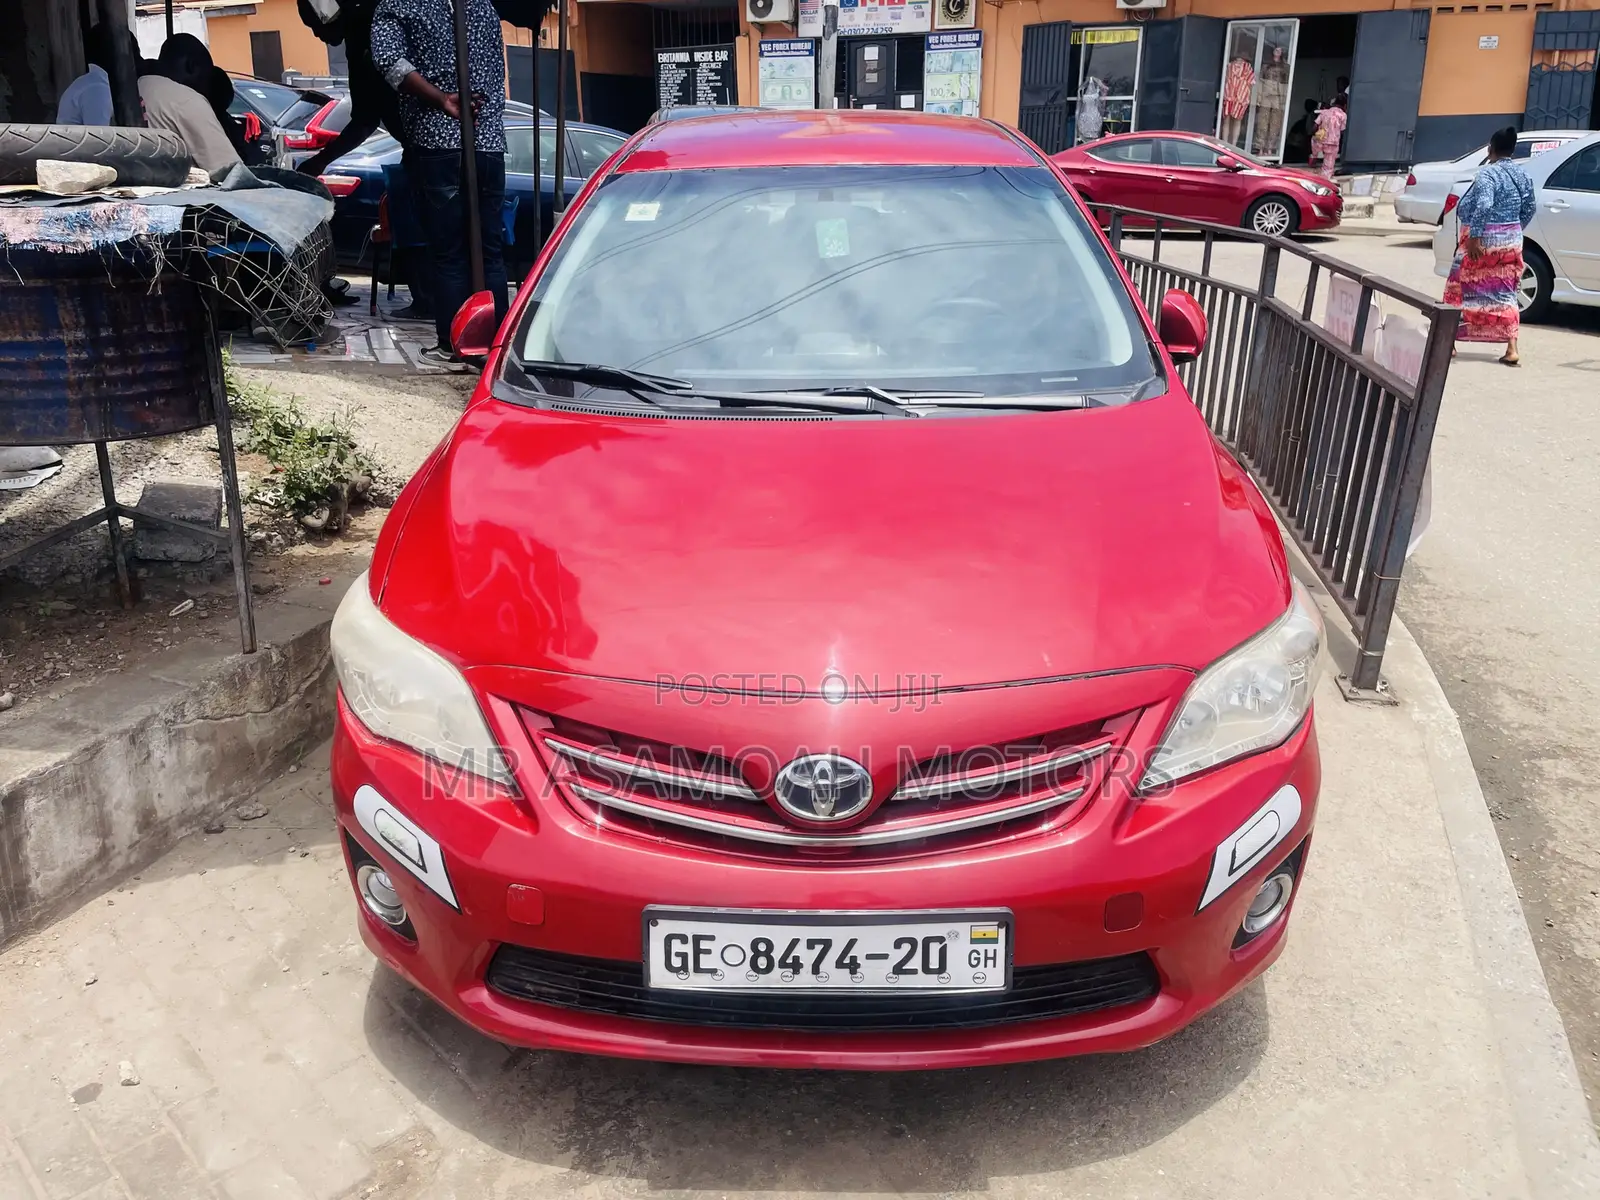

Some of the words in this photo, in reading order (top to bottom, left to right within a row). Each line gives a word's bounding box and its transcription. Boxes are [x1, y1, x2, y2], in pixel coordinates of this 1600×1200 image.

[928, 36, 939, 44] VEC
[939, 34, 957, 43] FOREX
[958, 33, 980, 42] BUREAU
[761, 43, 772, 51] VEC
[790, 42, 812, 50] BUREAU
[657, 52, 691, 63] BRITANNIA
[694, 51, 714, 62] INSIDE
[715, 50, 728, 62] BAR
[664, 933, 718, 973] GE
[749, 935, 948, 976] 8474-20
[967, 948, 997, 969] GH
